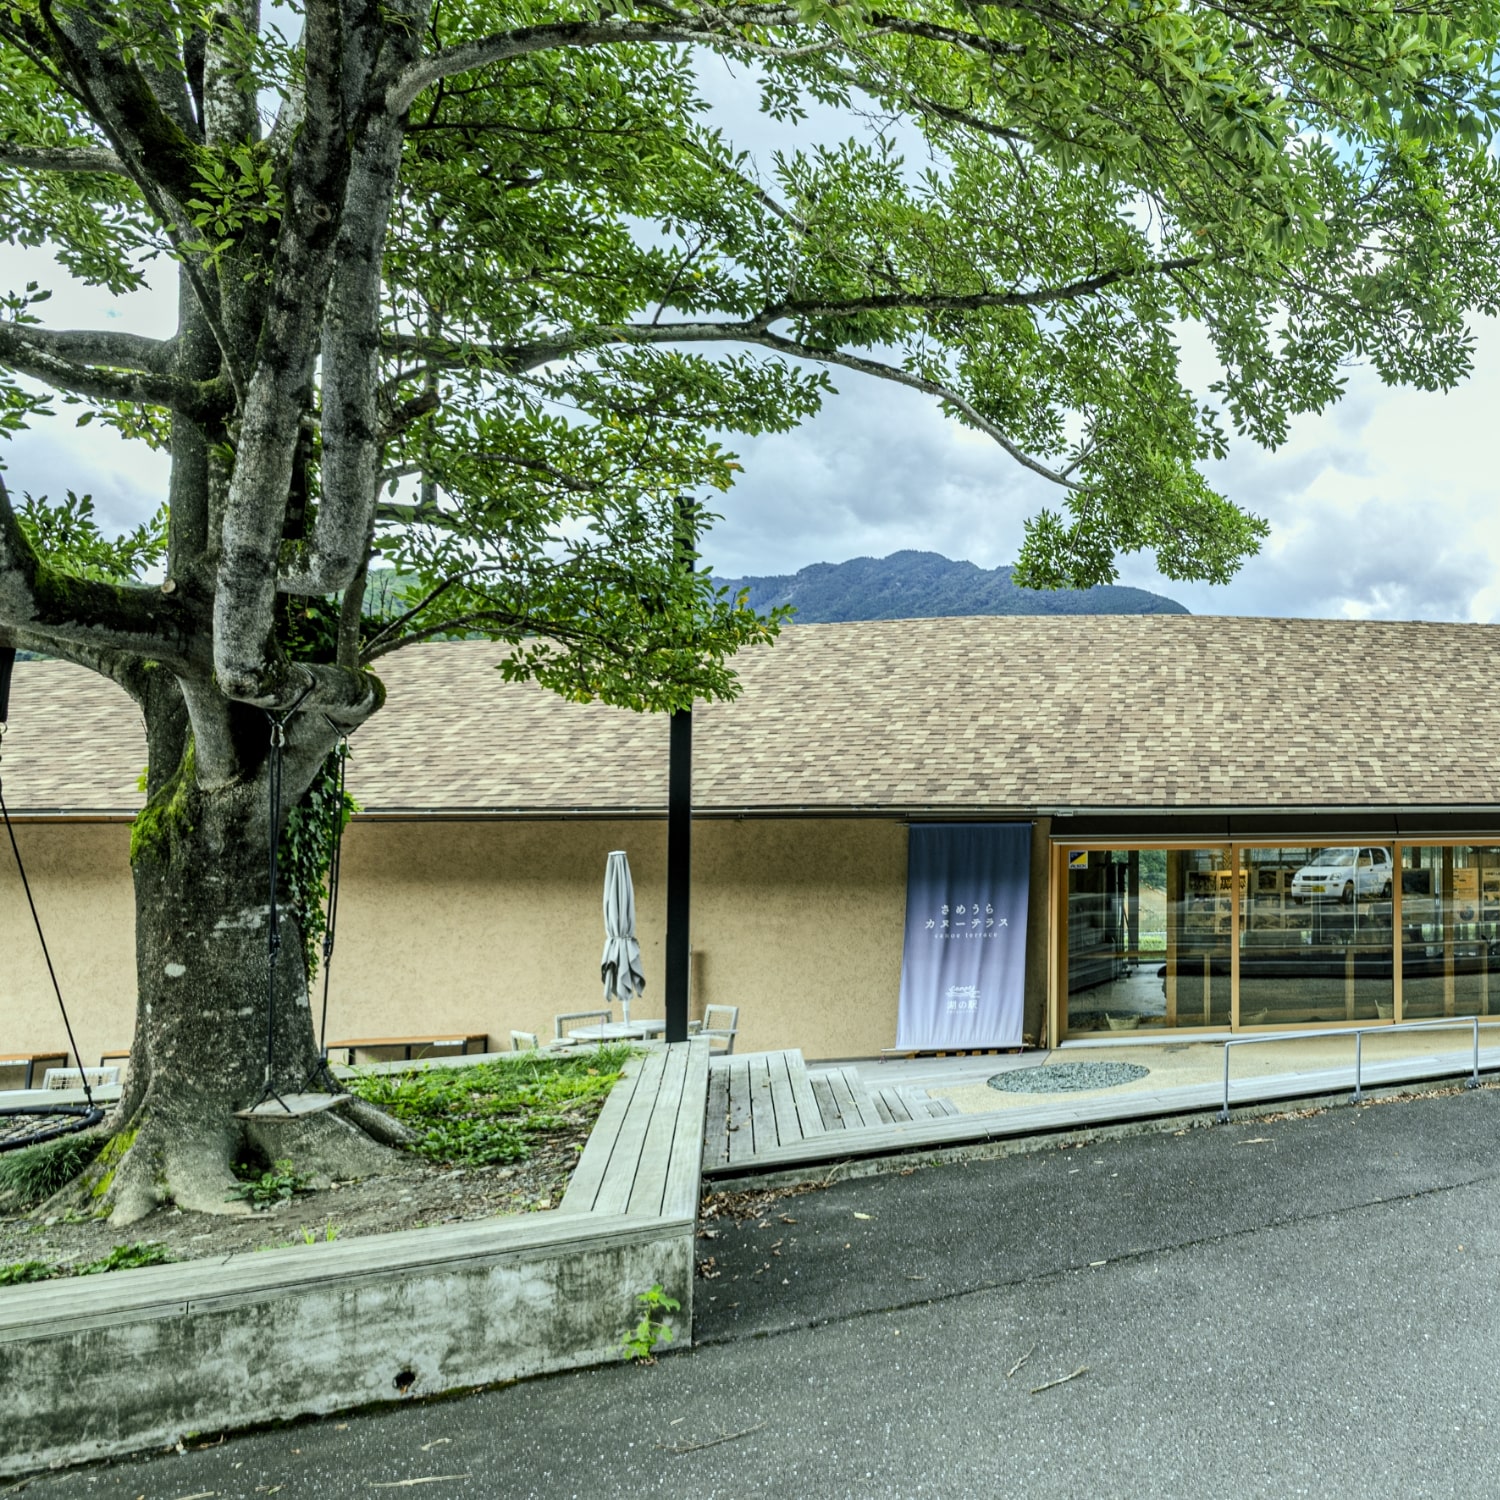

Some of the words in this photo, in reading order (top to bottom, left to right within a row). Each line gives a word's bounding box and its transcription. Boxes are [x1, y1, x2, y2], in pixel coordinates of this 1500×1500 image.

[941, 903, 994, 915] さめうら
[925, 918, 1008, 929] カヌーテラス
